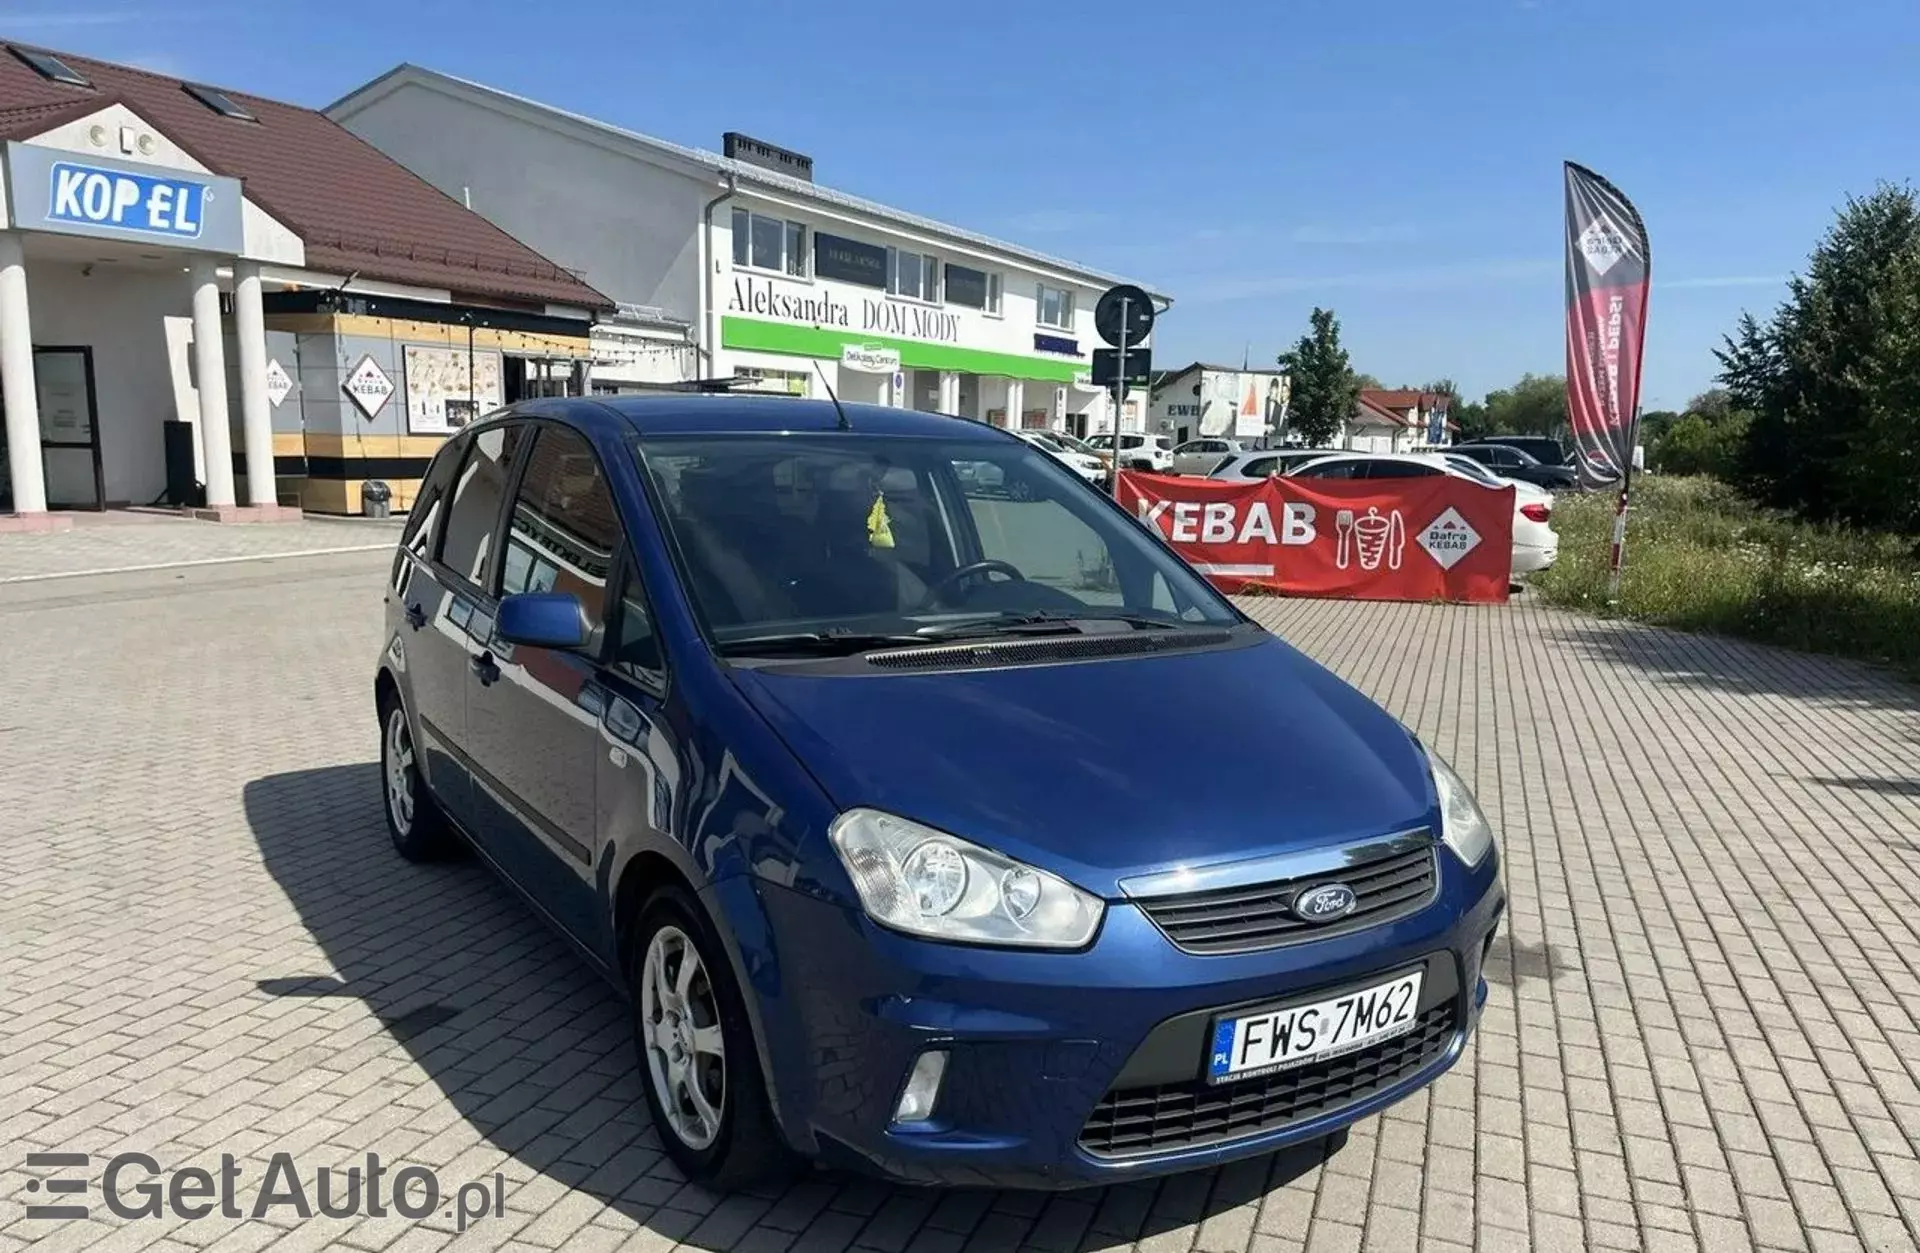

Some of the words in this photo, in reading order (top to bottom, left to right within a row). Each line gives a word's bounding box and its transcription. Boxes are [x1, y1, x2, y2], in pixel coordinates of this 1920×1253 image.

[729, 277, 849, 327] Aleksandra
[863, 298, 906, 336] DOM
[912, 306, 961, 342] MODY
[1138, 499, 1317, 546] KEBAB
[1429, 541, 1467, 550] KEBAB
[1430, 531, 1468, 541] Dafra
[1314, 890, 1345, 913] Ford
[1240, 1009, 1320, 1065] FWS
[1331, 981, 1413, 1043] 7M62
[1213, 1052, 1229, 1066] PL
